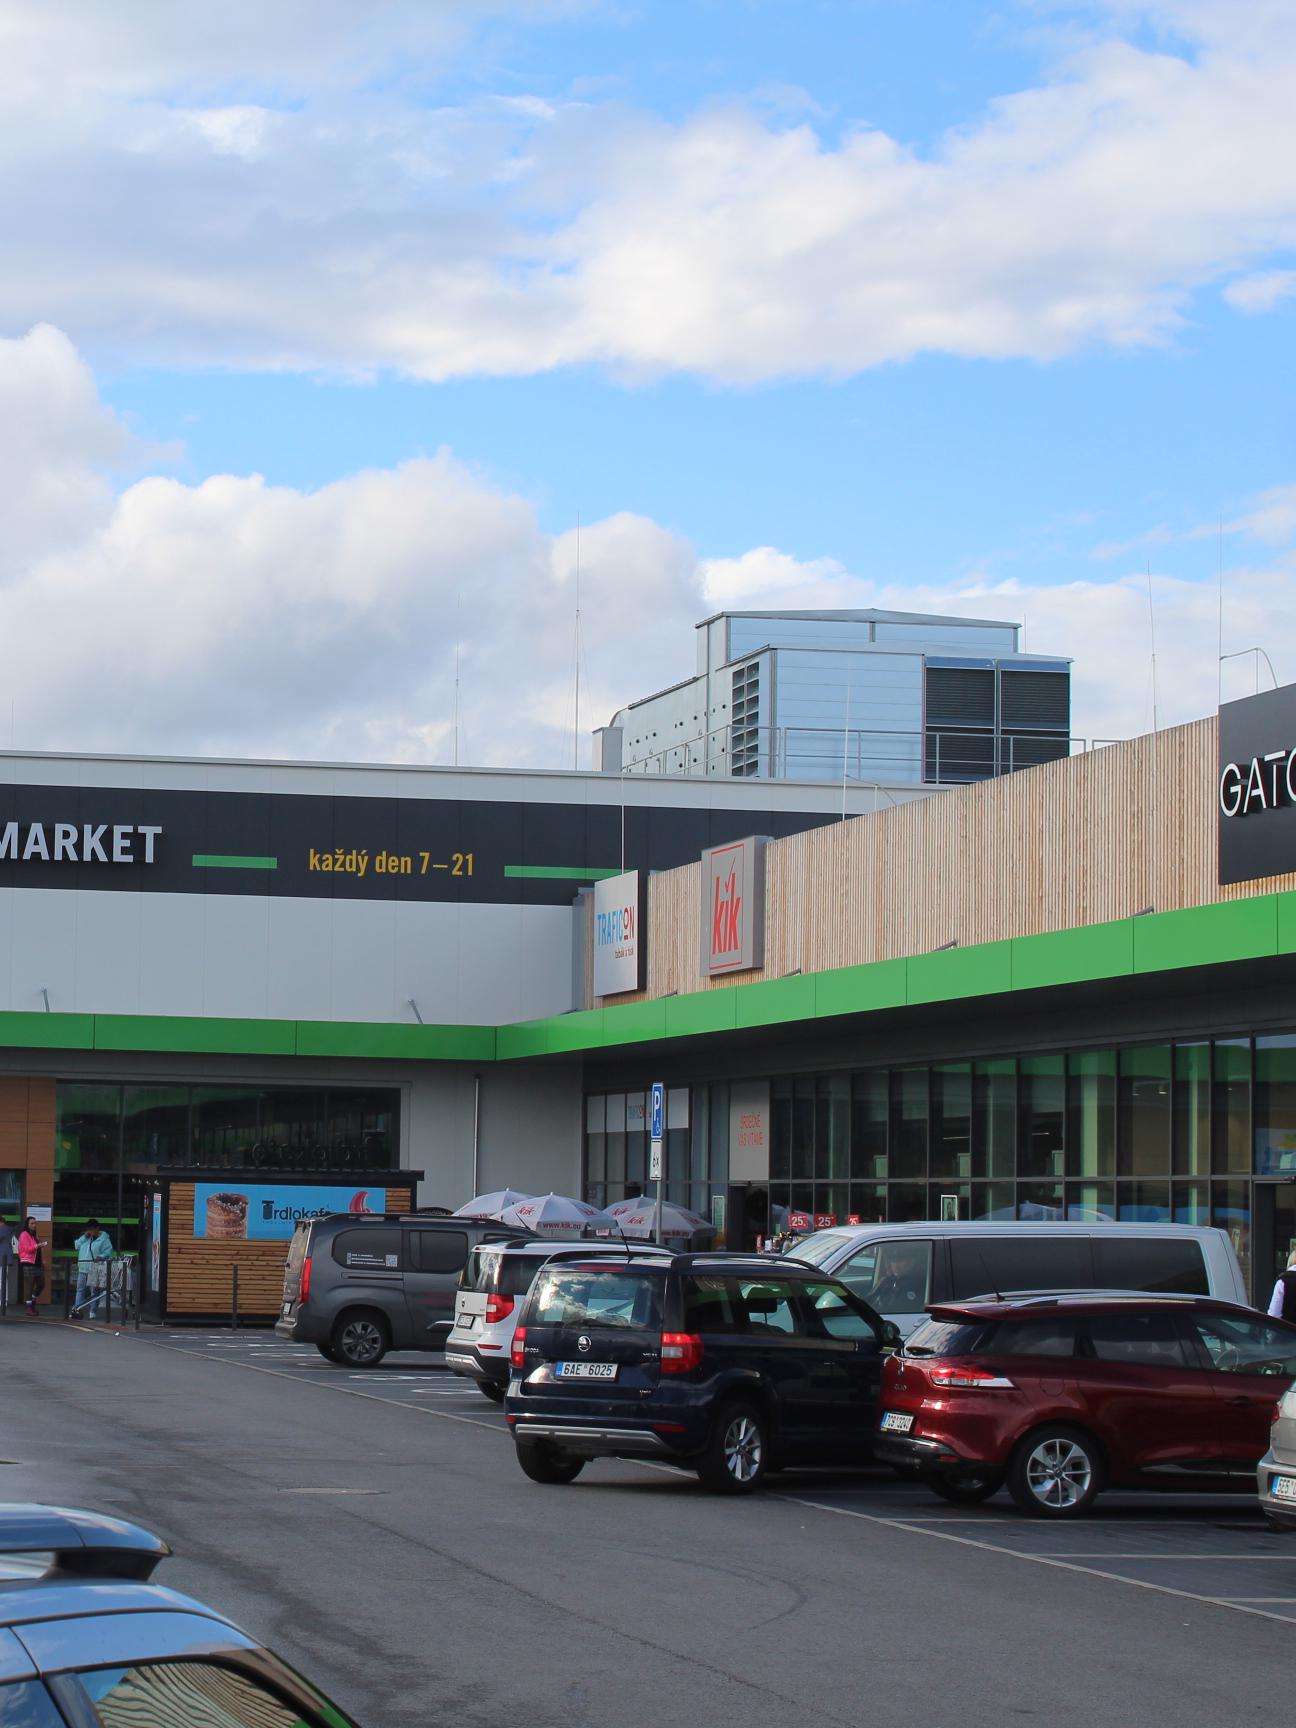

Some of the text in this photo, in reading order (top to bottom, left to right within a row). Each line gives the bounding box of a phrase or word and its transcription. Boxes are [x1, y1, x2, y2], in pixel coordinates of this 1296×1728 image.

[309, 848, 369, 877] každý
[375, 850, 412, 874] den
[597, 906, 635, 946] TRAFICON
[654, 1090, 661, 1122] P
[542, 1221, 582, 1231] www.kik.eu
[791, 1215, 804, 1227] 25
[818, 1216, 831, 1227] 25
[563, 1363, 613, 1377] 6AE 6025
